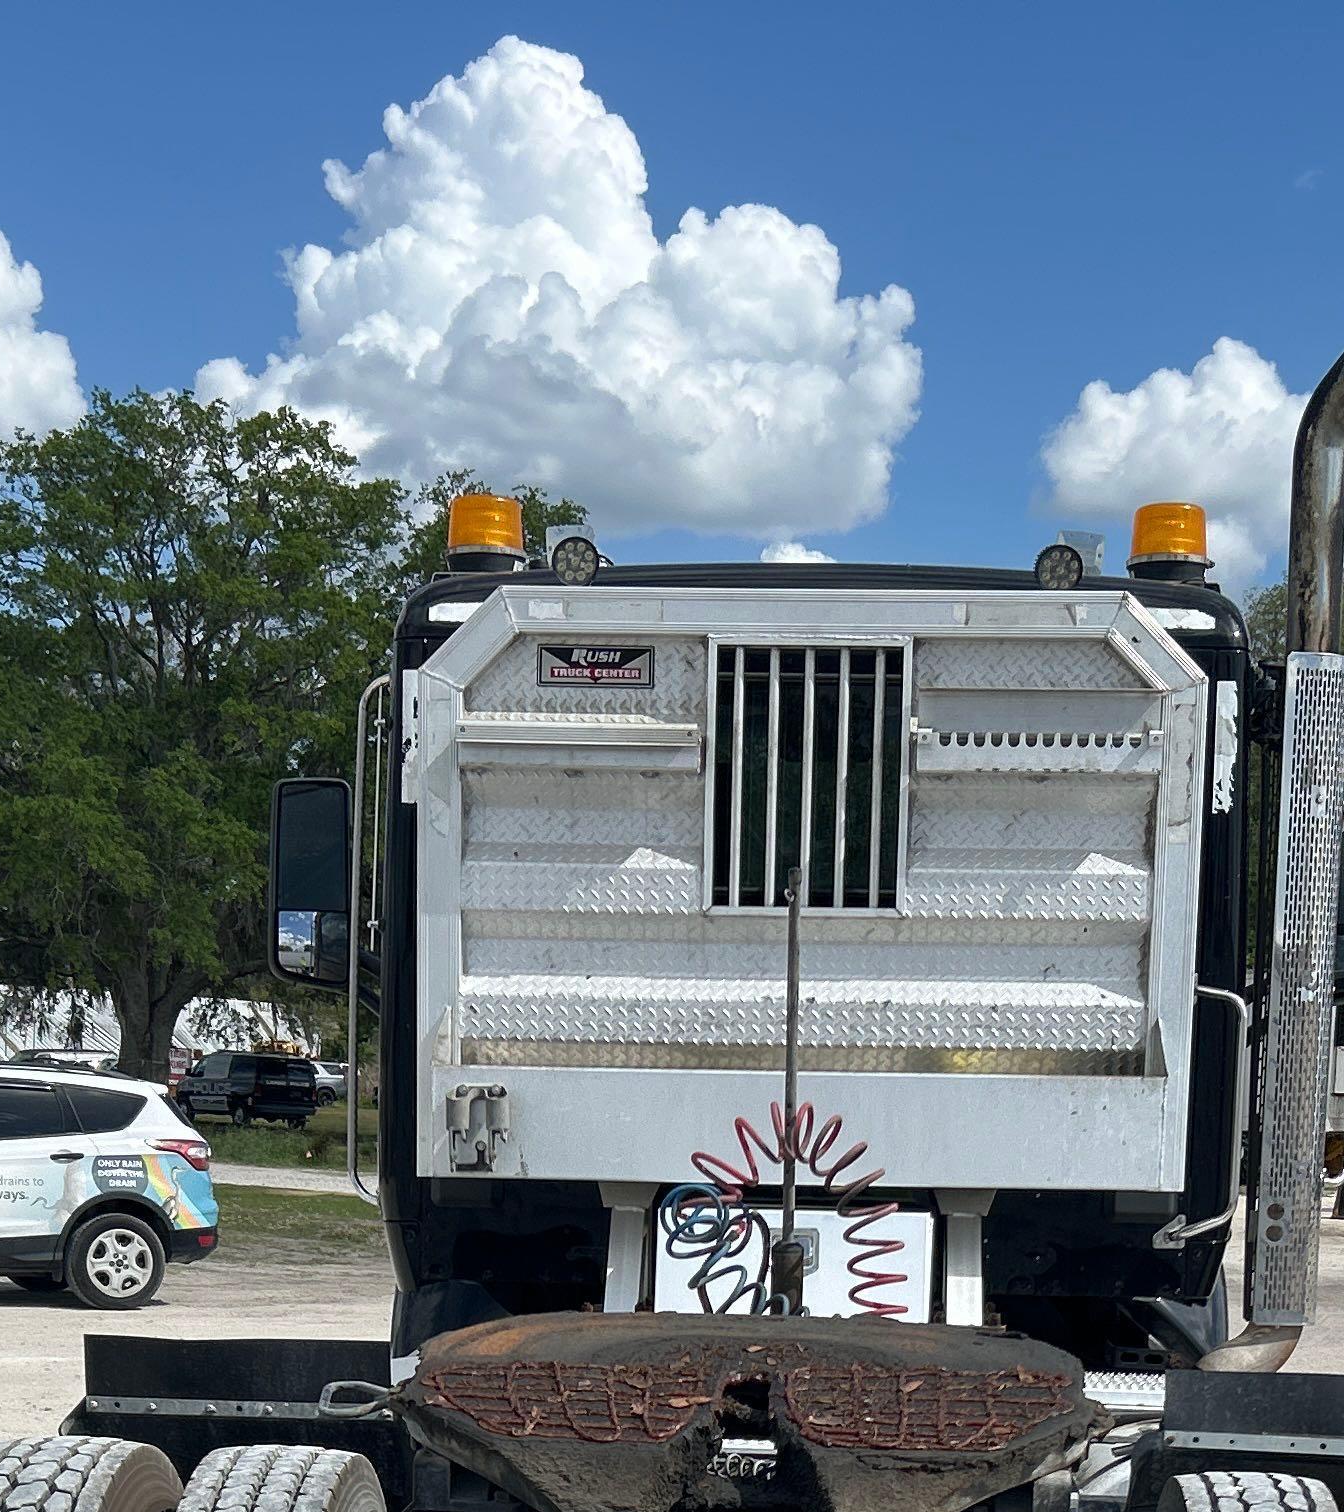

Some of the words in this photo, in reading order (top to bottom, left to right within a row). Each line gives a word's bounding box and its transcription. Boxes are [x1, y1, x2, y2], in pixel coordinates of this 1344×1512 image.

[571, 648, 621, 666] RUSH
[552, 668, 592, 678] TRUCK
[594, 668, 640, 678] CENTER
[97, 1159, 121, 1168] ONLY
[32, 1177, 45, 1187] to
